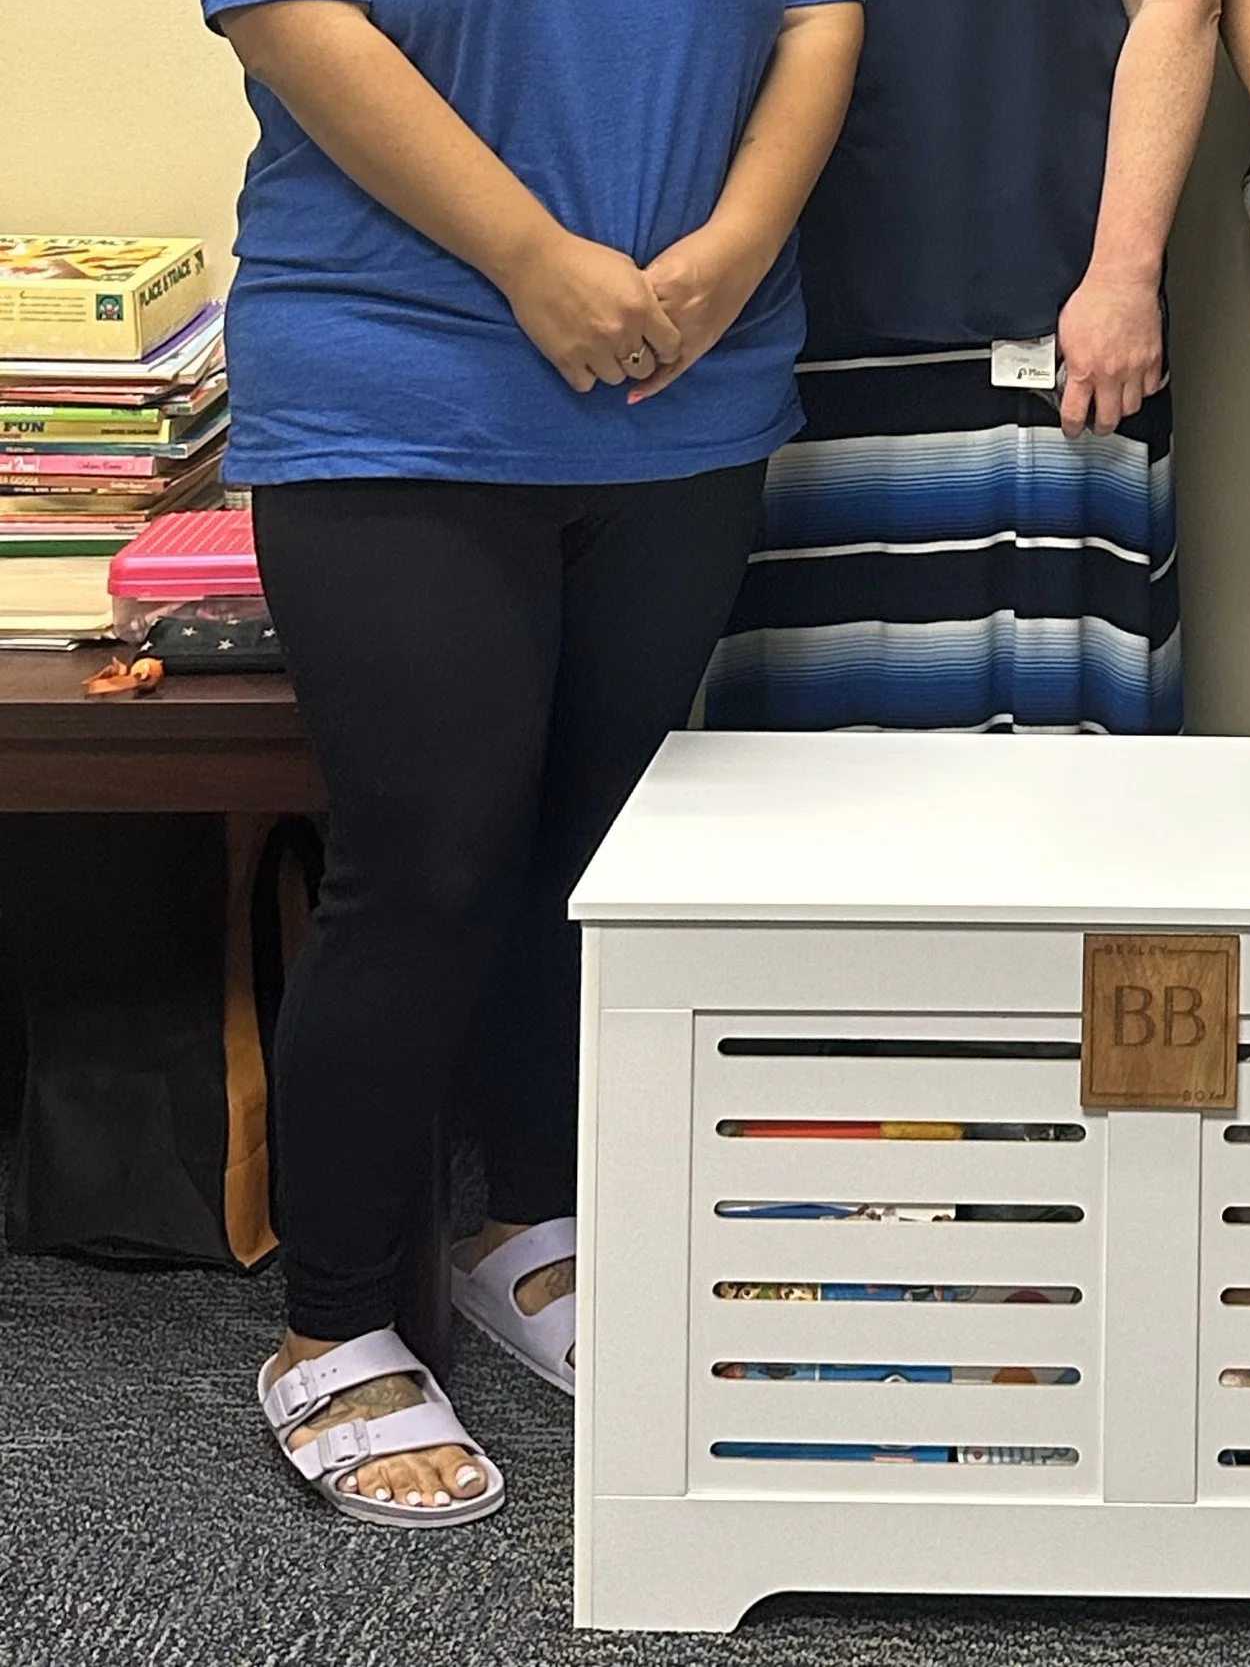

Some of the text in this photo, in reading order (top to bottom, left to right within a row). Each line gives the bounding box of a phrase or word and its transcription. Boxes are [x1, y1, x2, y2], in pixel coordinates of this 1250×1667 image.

[4, 421, 45, 433] FUN
[1114, 985, 1206, 1047] BB
[1183, 1090, 1216, 1103] BOX
